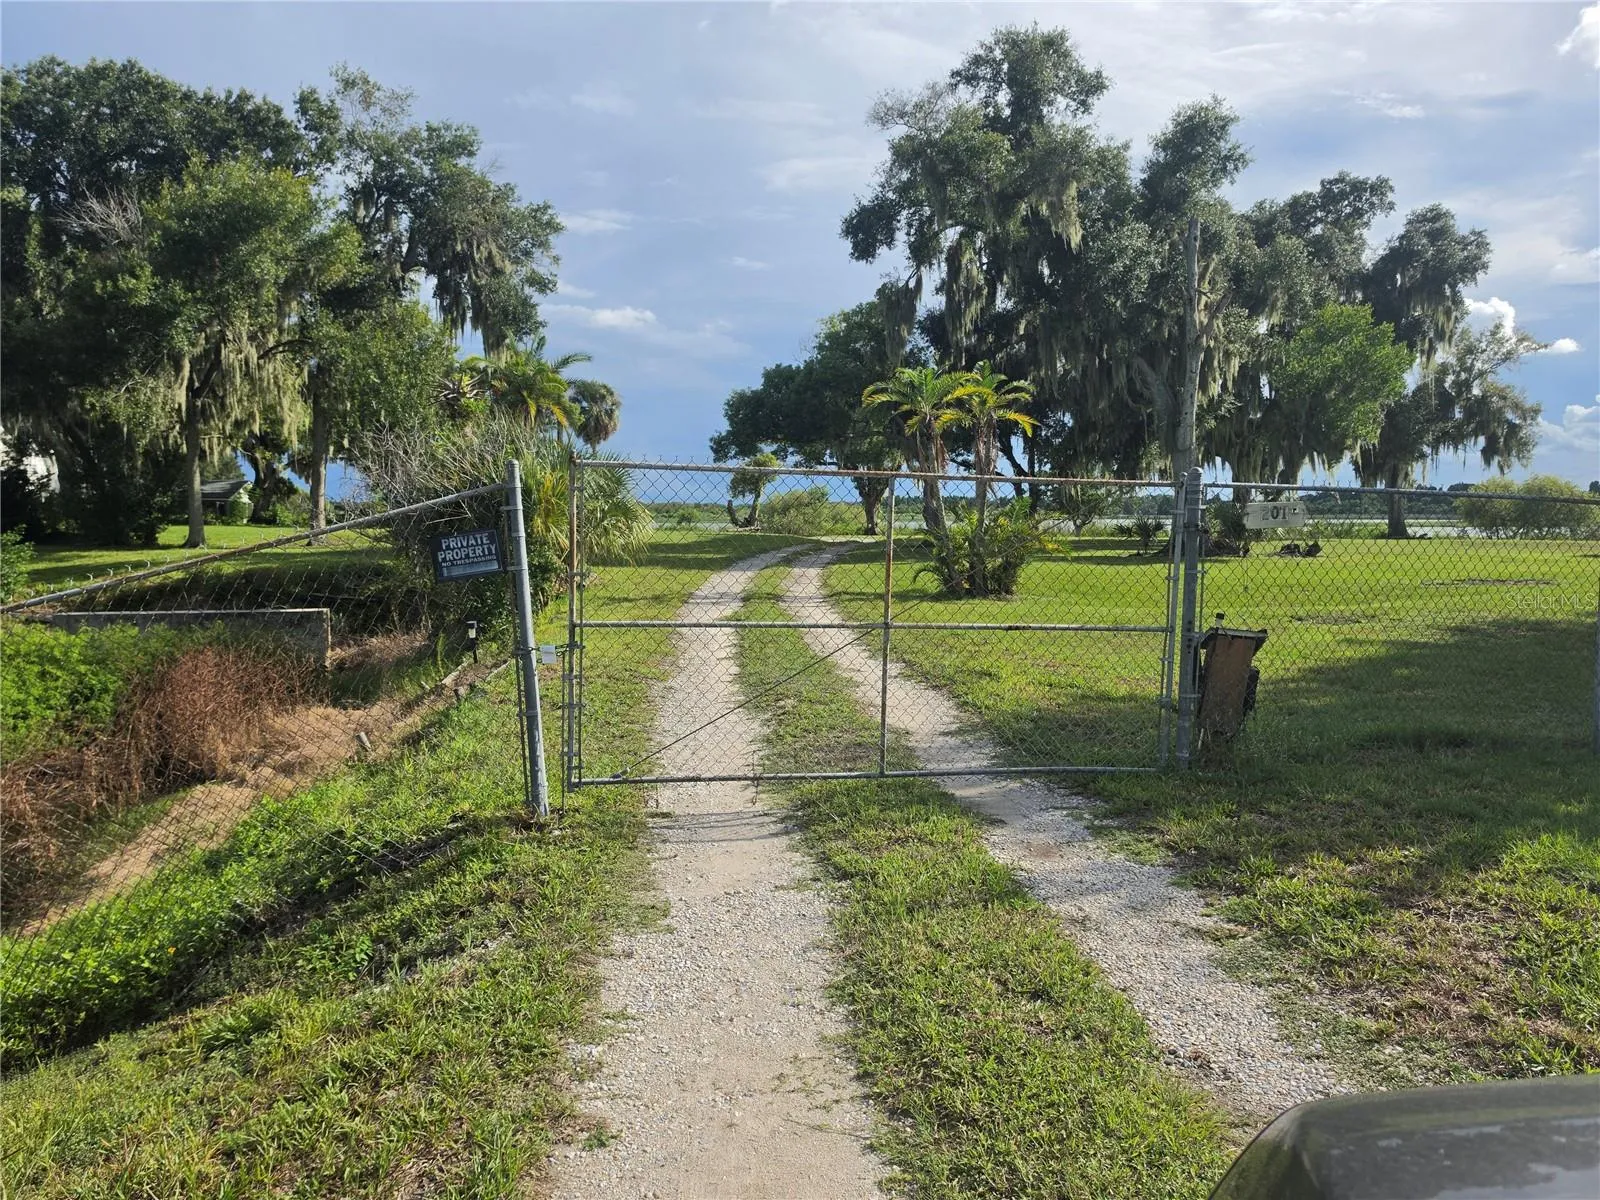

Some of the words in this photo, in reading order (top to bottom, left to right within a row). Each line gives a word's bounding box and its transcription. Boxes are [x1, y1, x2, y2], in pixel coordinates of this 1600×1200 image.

[441, 533, 490, 550] PRIVATE
[437, 544, 496, 562] PROPERTY
[454, 555, 497, 565] TRESPASSING
